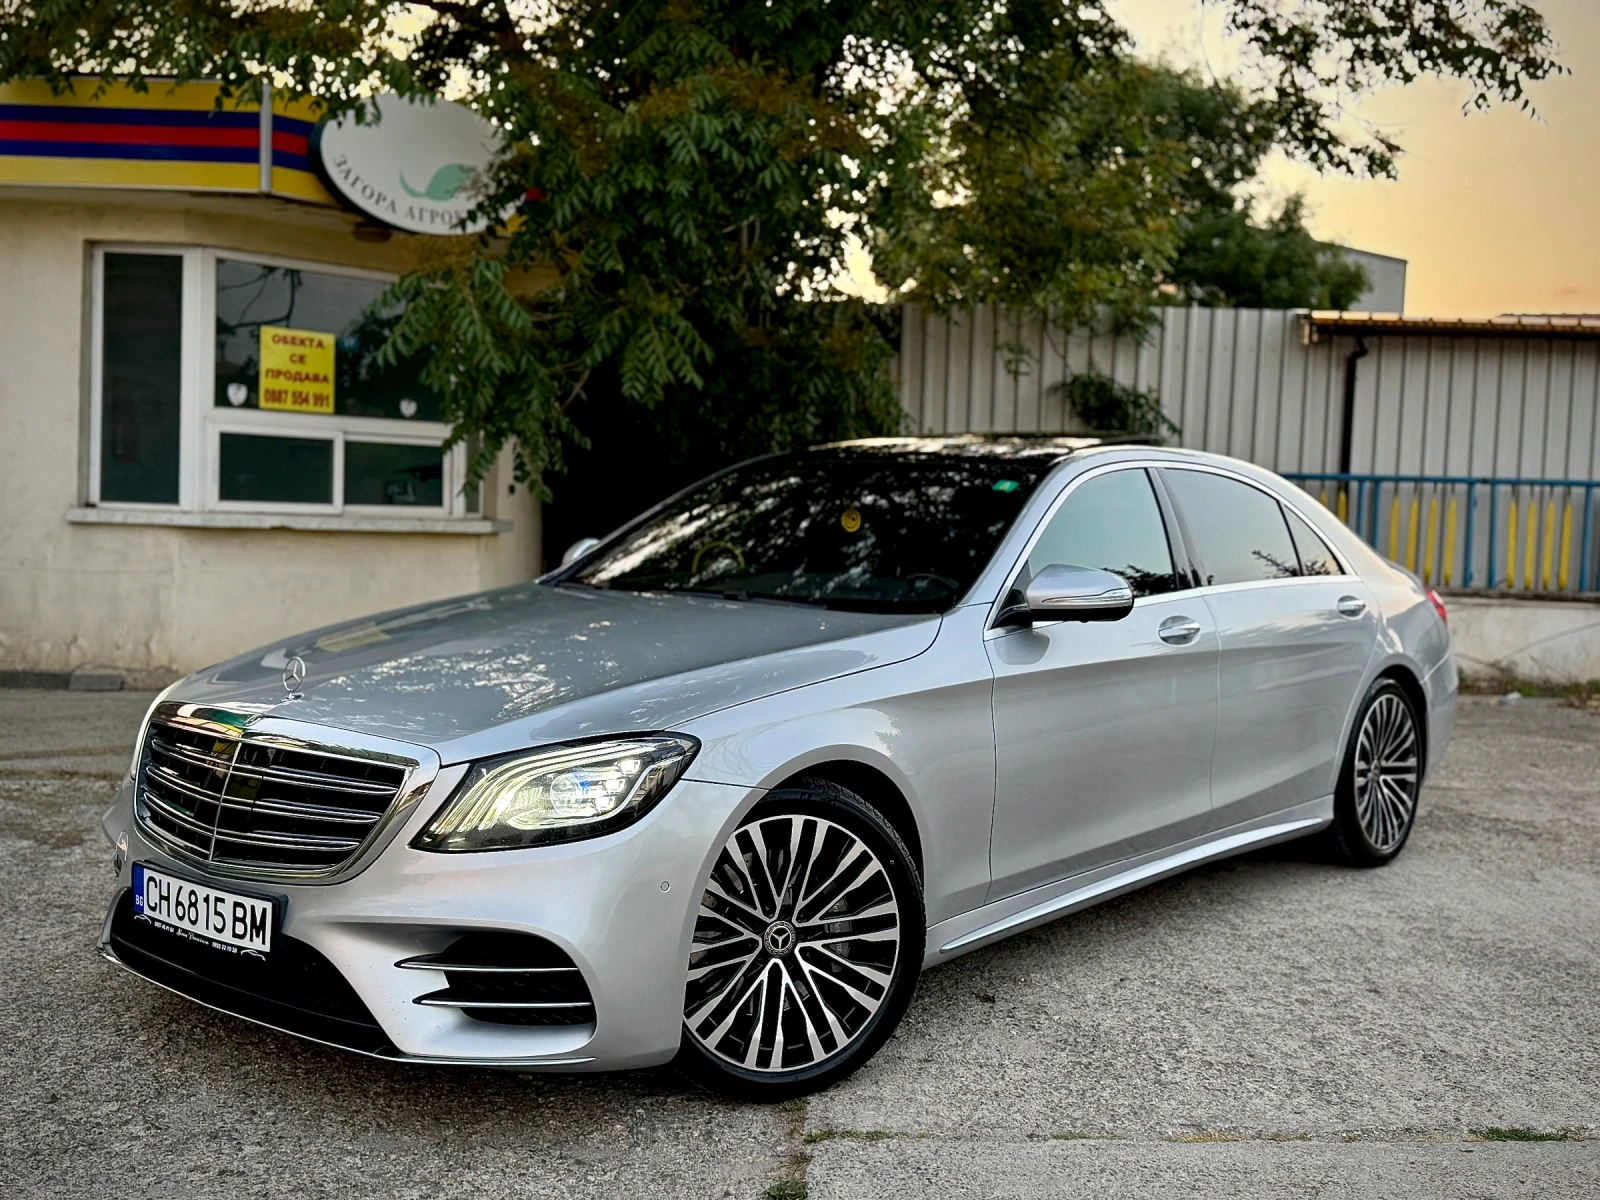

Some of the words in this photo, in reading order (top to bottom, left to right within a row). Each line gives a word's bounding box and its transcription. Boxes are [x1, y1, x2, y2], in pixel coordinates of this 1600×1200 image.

[333, 154, 398, 214] ЗАГОРА
[271, 333, 325, 349] ОБЕКТА
[289, 353, 306, 365] СЕ
[264, 368, 329, 384] ПРОДАВА
[135, 894, 144, 907] BG
